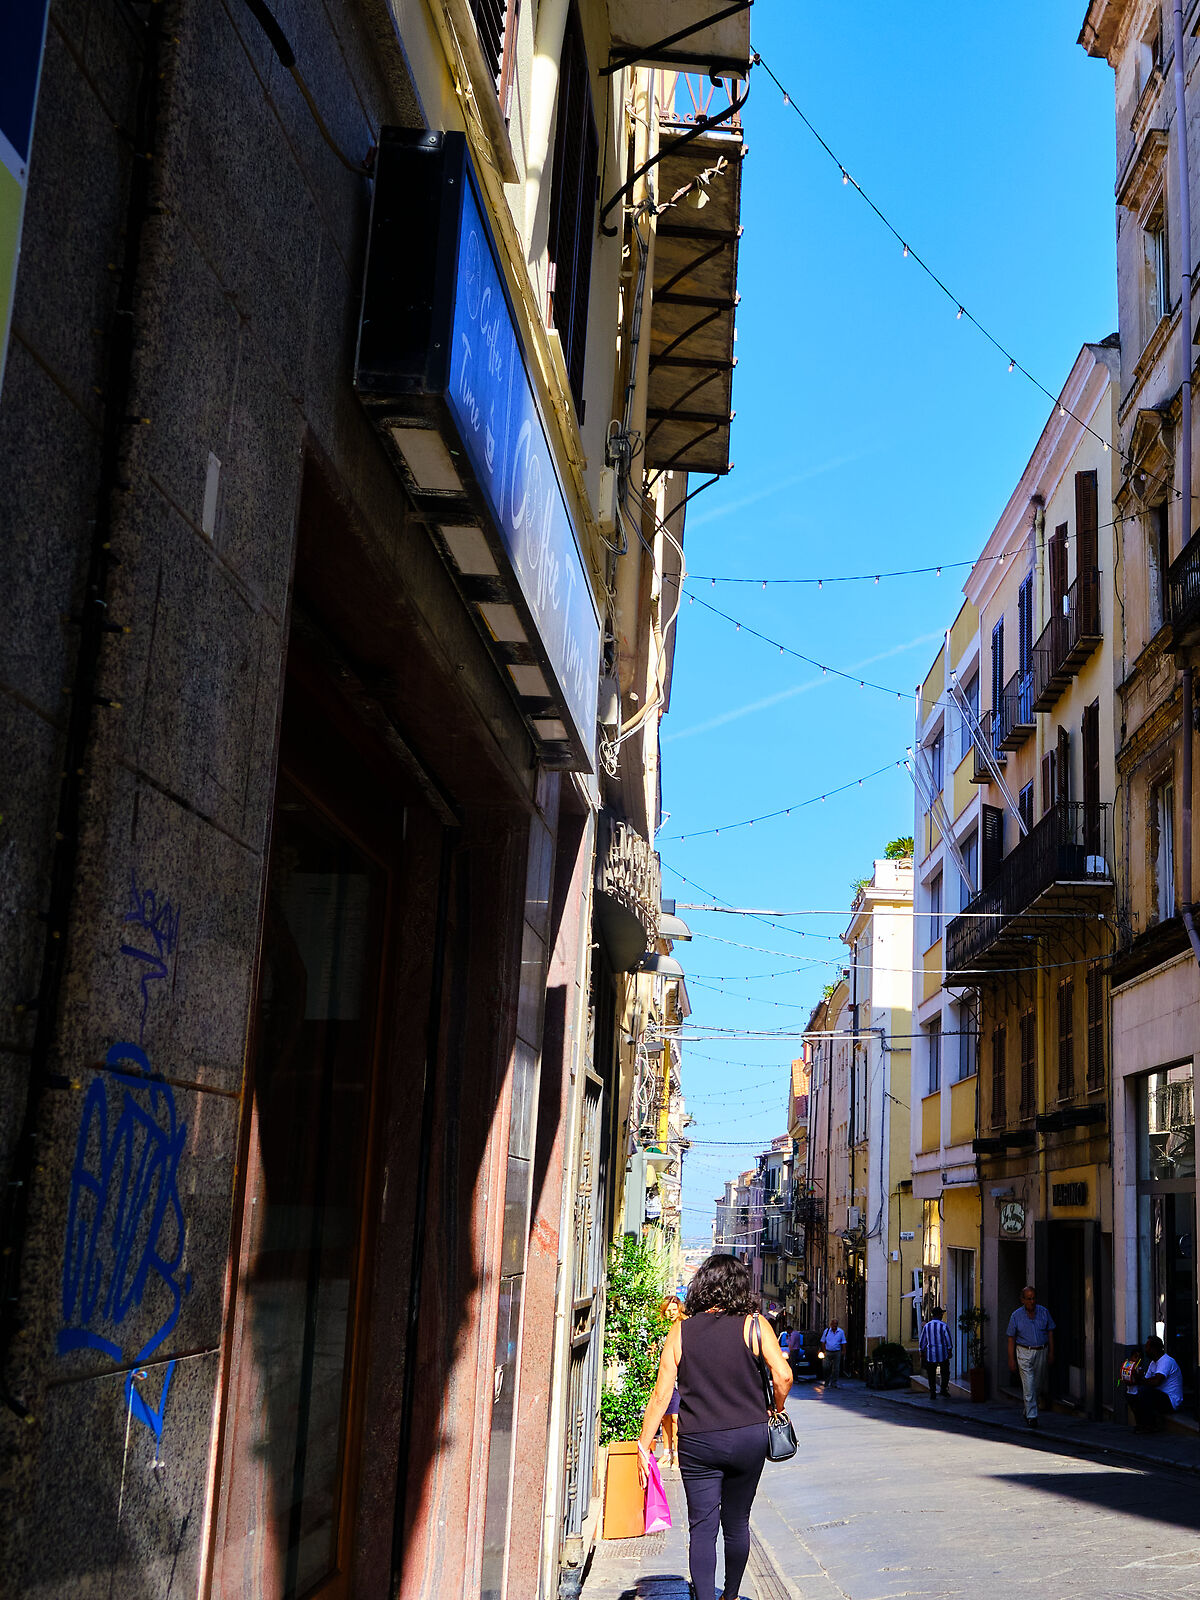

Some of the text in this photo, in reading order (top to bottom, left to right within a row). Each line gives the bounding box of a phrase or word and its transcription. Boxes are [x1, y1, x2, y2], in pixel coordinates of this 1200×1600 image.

[459, 332, 481, 432] Time
[480, 286, 503, 382] Coffee
[562, 552, 585, 701] Time
